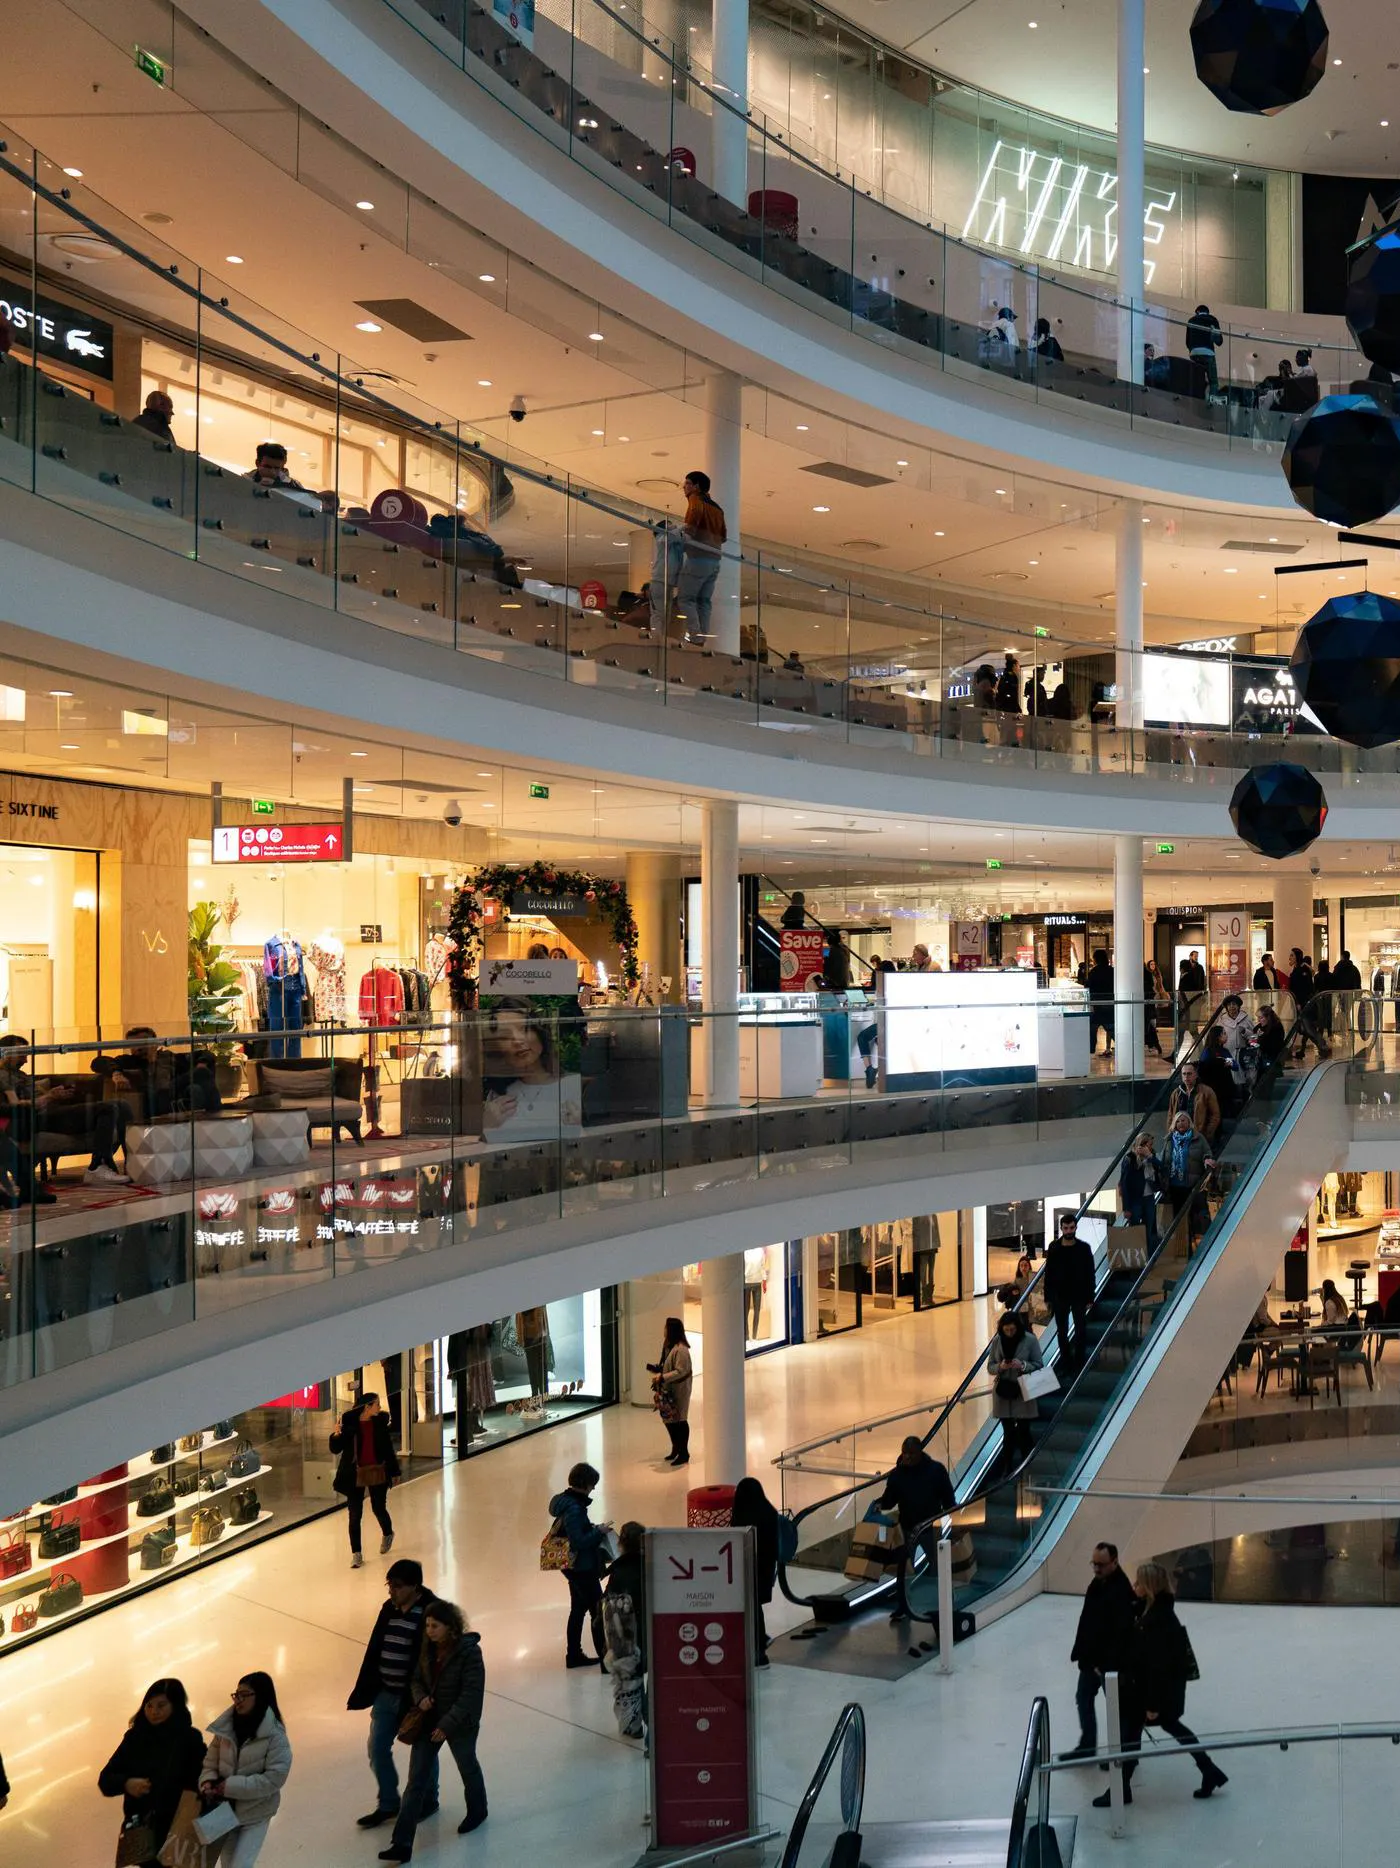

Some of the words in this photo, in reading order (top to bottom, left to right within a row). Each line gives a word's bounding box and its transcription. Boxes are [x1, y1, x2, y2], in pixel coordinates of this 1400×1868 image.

[1270, 707, 1301, 716] PARIS
[8, 801, 60, 820] SIXTINE
[782, 931, 821, 949] Save
[972, 925, 979, 944] 2
[701, 1541, 733, 1585] -1
[686, 1592, 715, 1601] MAISON
